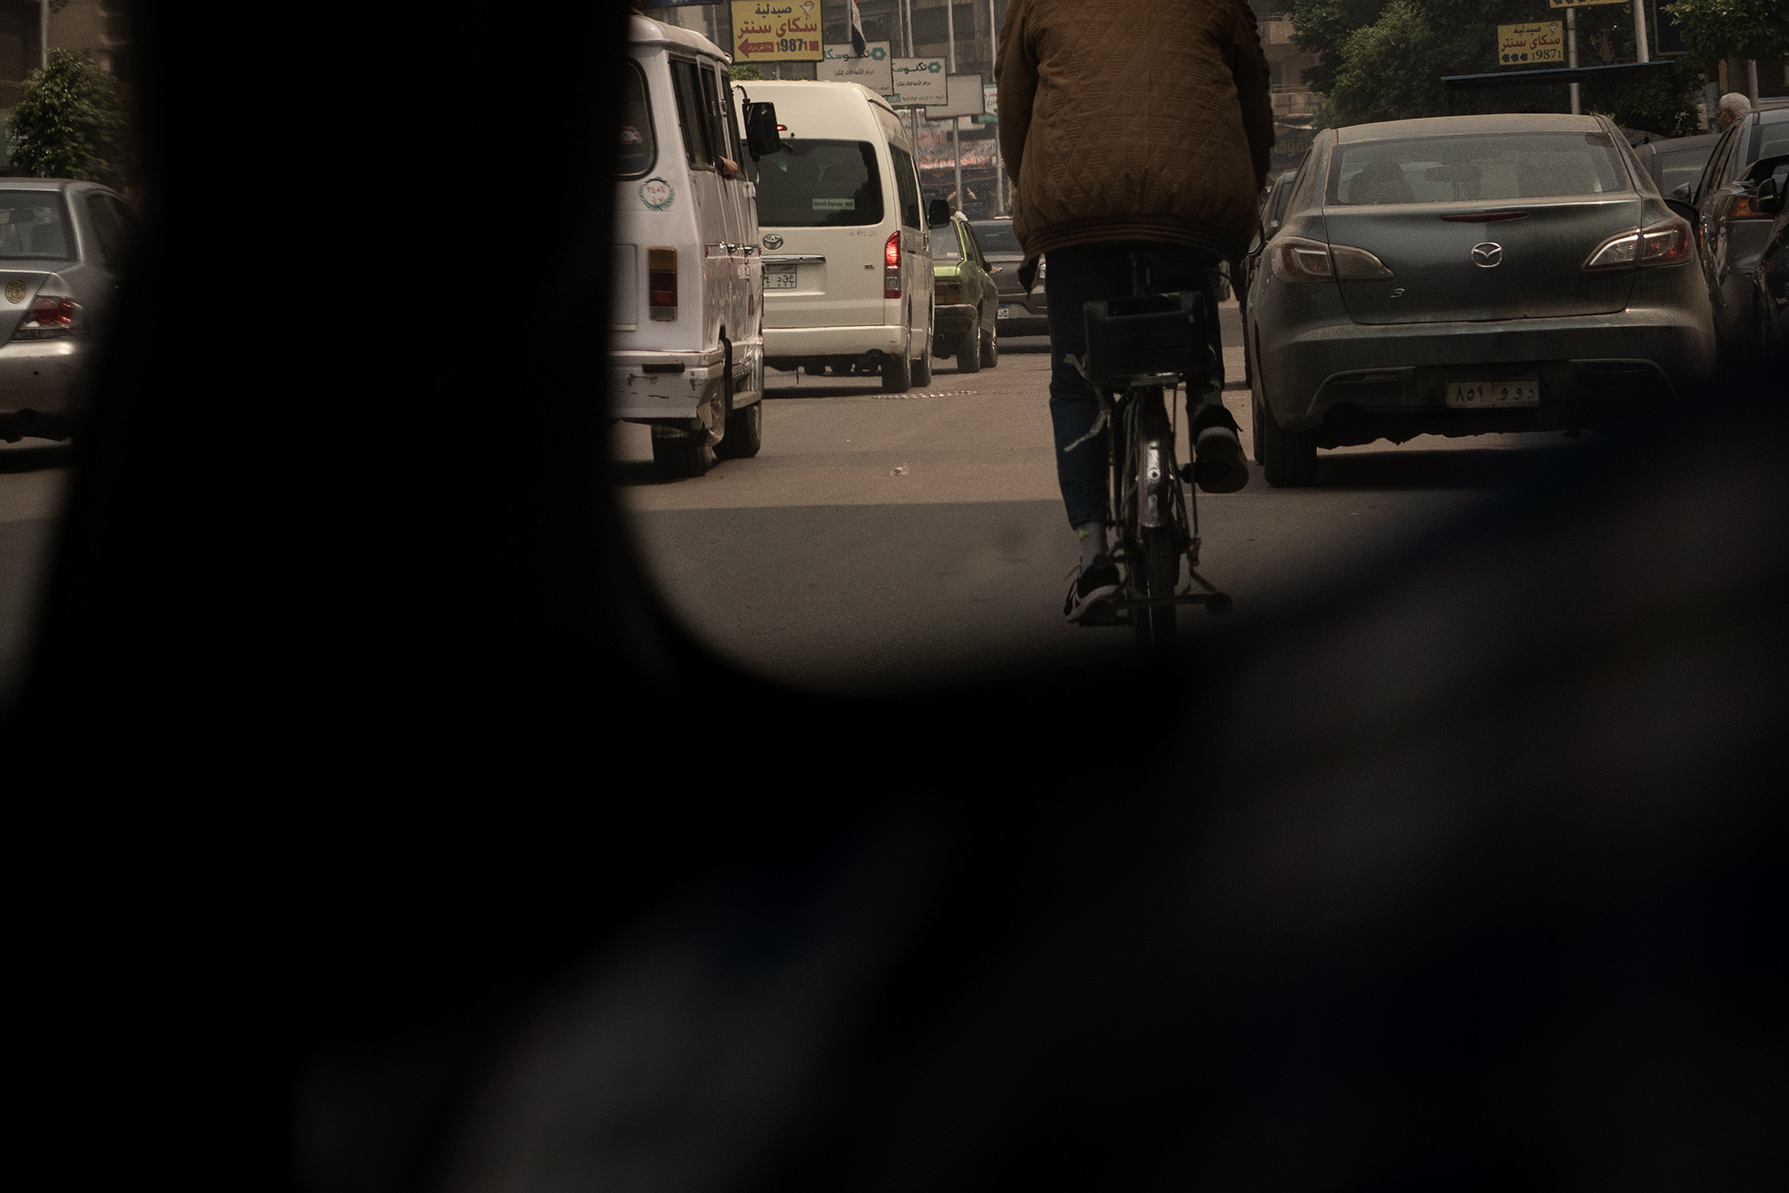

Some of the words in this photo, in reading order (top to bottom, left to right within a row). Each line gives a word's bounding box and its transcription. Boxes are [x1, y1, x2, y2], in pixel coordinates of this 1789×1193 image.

[754, 3, 792, 18] صيدلية
[737, 21, 772, 39] سنتر
[1513, 25, 1542, 36] صيدلية
[1501, 38, 1527, 52] سنتر
